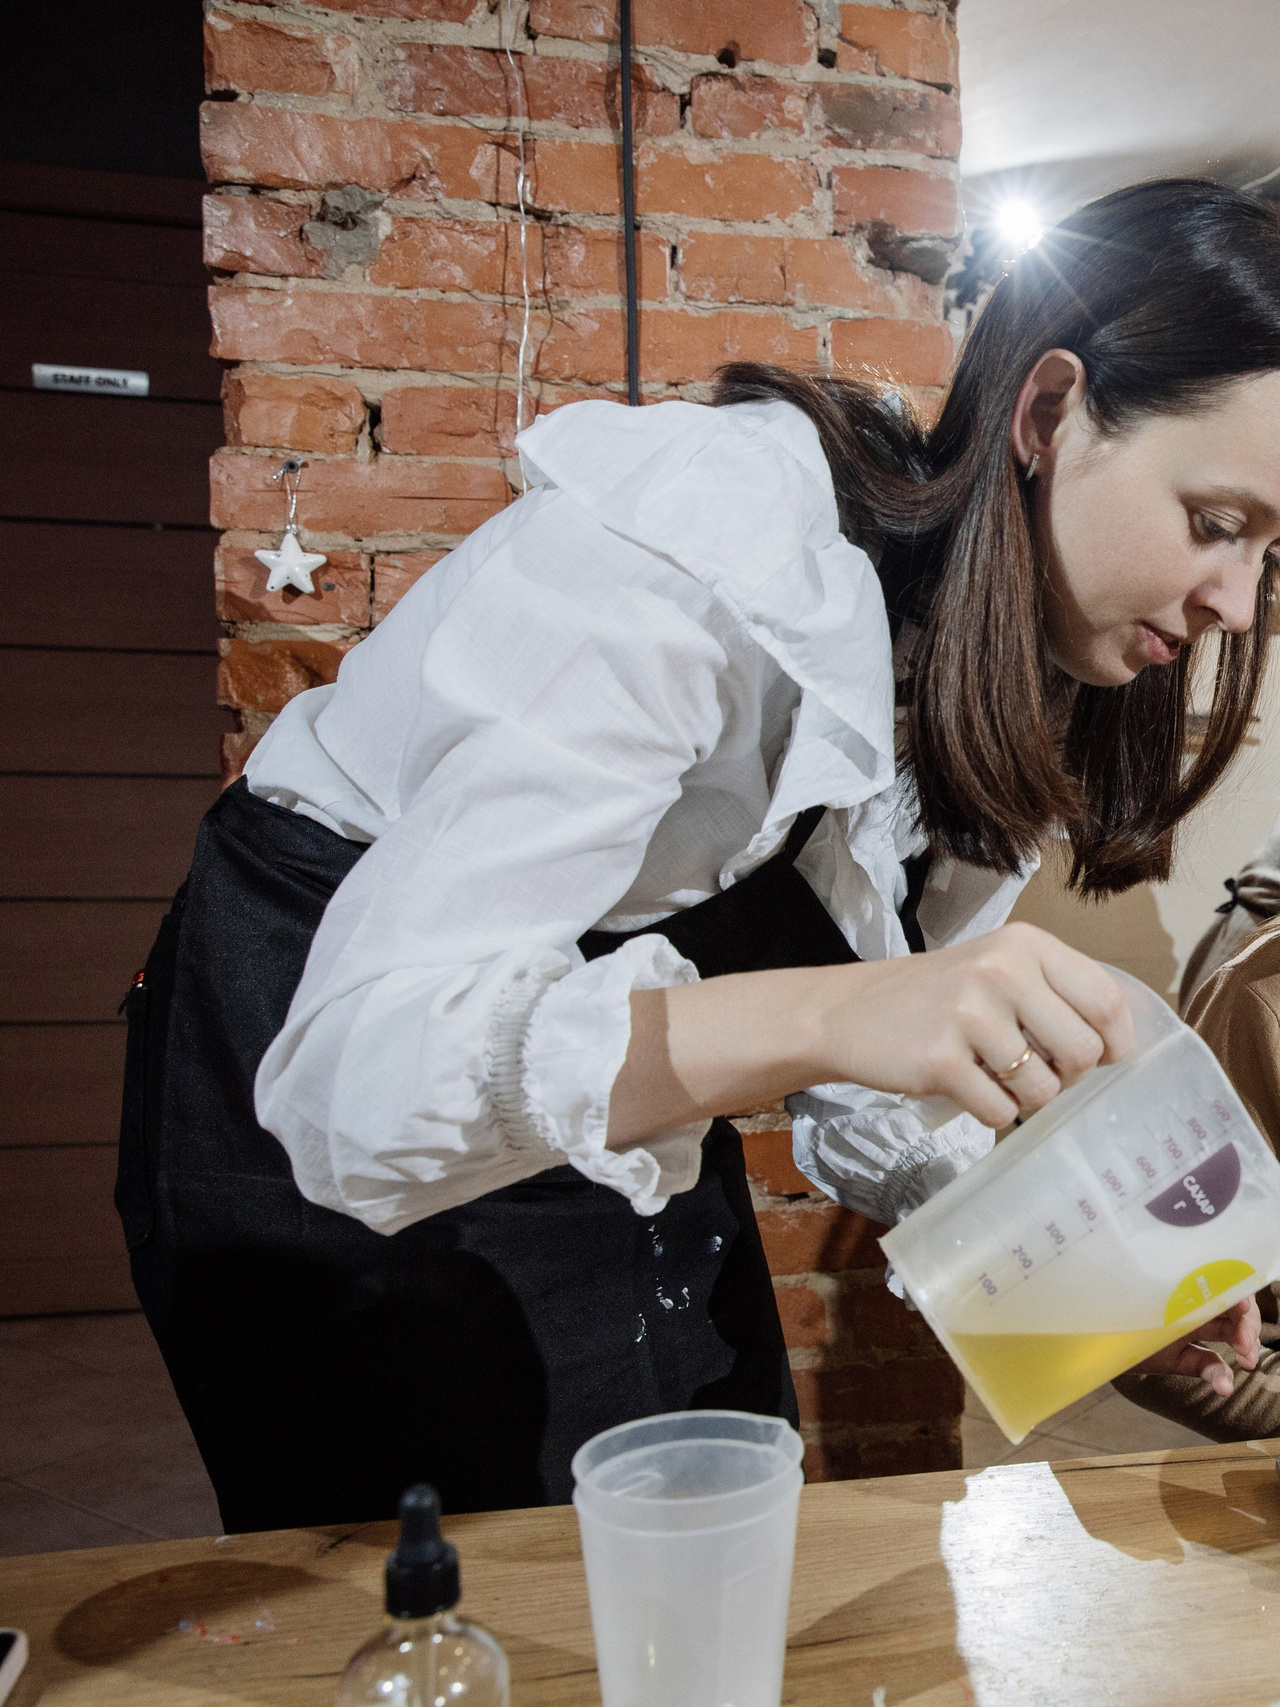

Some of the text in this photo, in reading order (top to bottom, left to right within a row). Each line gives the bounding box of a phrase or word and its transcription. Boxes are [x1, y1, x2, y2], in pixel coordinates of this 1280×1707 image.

[53, 373, 90, 385] STAFF
[1163, 1135, 1183, 1159] 700
[1136, 1156, 1156, 1178] 600
[1077, 1199, 1097, 1221] 400
[1044, 1221, 1066, 1245] 300
[1012, 1245, 1033, 1269] 200
[978, 1272, 998, 1295] 100
